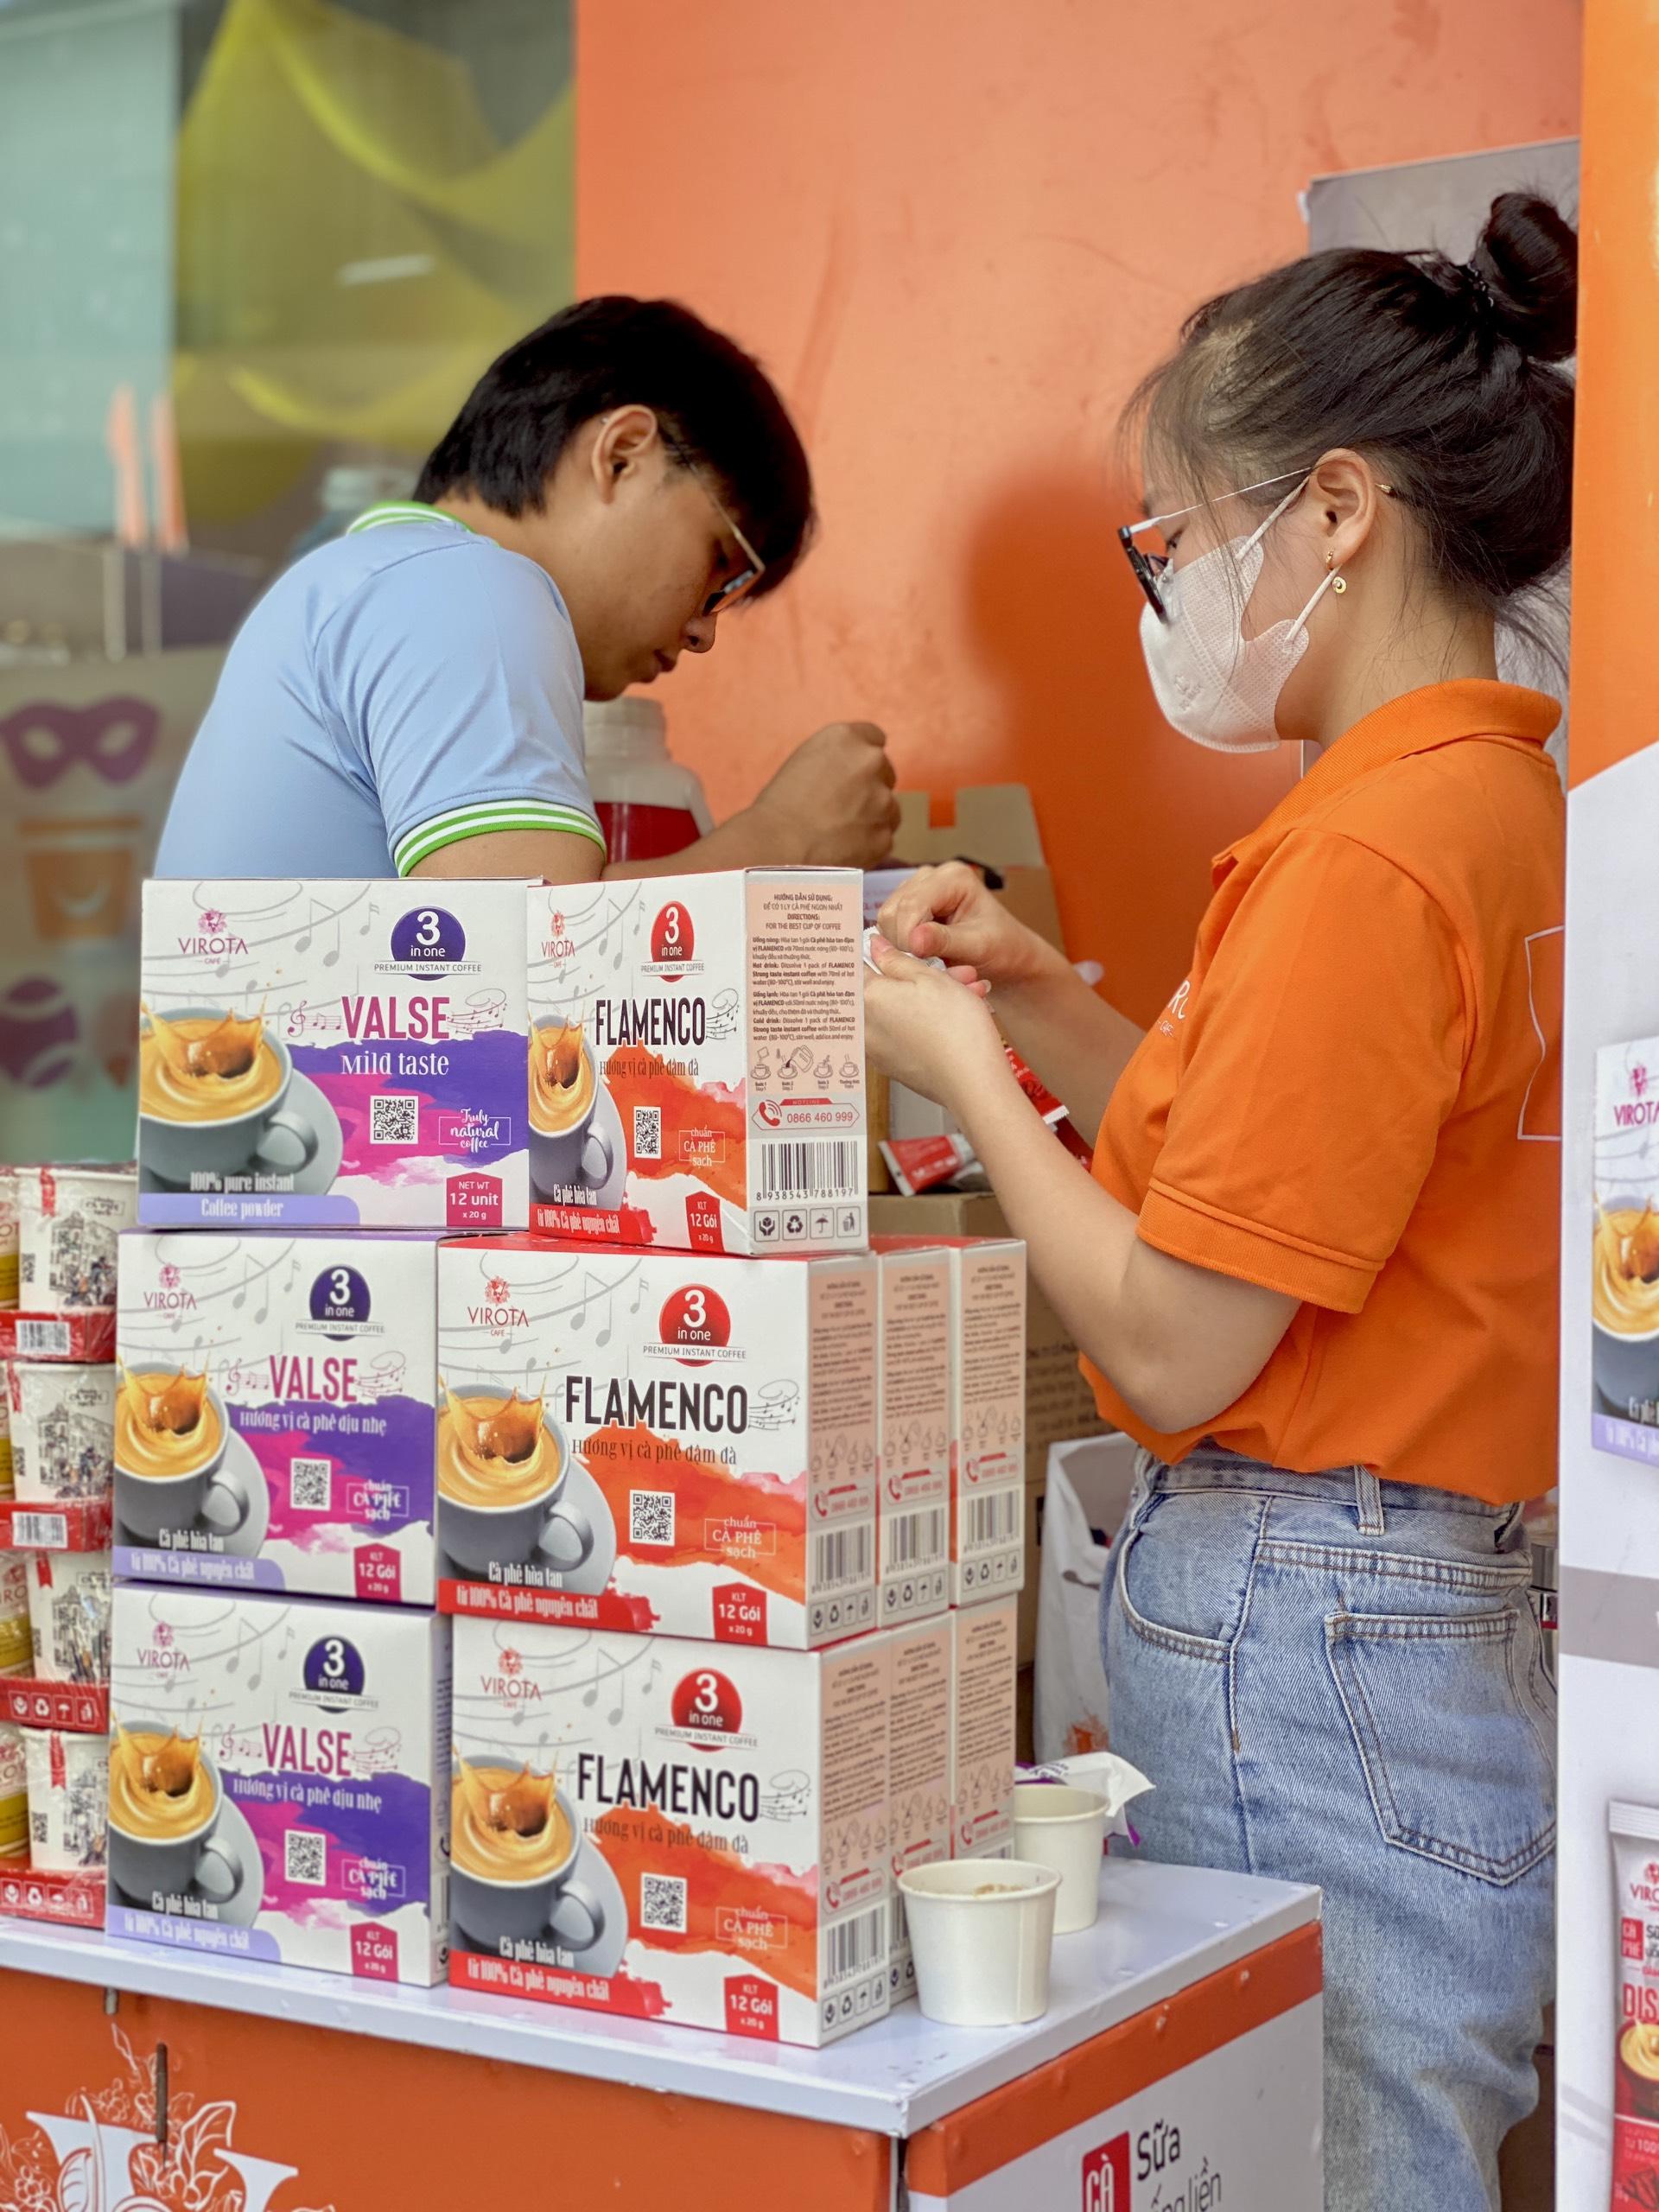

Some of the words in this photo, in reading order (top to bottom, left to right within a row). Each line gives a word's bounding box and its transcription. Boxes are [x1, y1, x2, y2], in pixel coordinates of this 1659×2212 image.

[416, 911, 441, 945] 3
[664, 906, 679, 944] 3
[178, 938, 249, 955] VIROTA
[410, 944, 421, 957] in
[423, 948, 446, 957] one
[541, 940, 576, 957] VIROTA
[661, 944, 668, 957] in
[669, 945, 683, 957] one
[416, 963, 449, 972] INSTANT
[640, 964, 663, 974] PREMIUM
[664, 963, 685, 972] INSTANT
[686, 963, 705, 972] COFFEE
[341, 995, 450, 1039] VALSE
[595, 996, 706, 1046] FLAMENCO
[340, 1050, 392, 1075] Mild
[397, 1052, 449, 1076] taste
[461, 1108, 490, 1127] Truly
[787, 1113, 811, 1123] 0866
[815, 1112, 832, 1122] 460
[836, 1111, 853, 1122] 999
[450, 1121, 499, 1141] natural
[460, 1137, 489, 1154] coffee
[224, 1175, 252, 1194] pure
[254, 1171, 295, 1192] instant
[458, 1181, 474, 1190] NET
[476, 1181, 490, 1190] WT
[449, 1192, 467, 1205] 12
[471, 1192, 499, 1206] unit
[200, 1198, 238, 1217] Coffee
[240, 1198, 283, 1220] powder
[690, 1213, 702, 1227] 12
[329, 1268, 350, 1306] 3
[143, 1291, 197, 1310] VIROTA
[683, 1289, 707, 1328] 3
[325, 1304, 334, 1316] in
[335, 1306, 355, 1318] one
[467, 1306, 529, 1327] VIROTA
[677, 1327, 687, 1340] in
[690, 1331, 711, 1341] one
[643, 1345, 680, 1356] PREMIUM
[682, 1347, 715, 1357] INSTANT
[717, 1349, 747, 1359] COFFEE
[270, 1355, 358, 1402] VALSE
[565, 1375, 748, 1434] FLAMENCO
[359, 1563, 374, 1578] 12
[731, 1592, 747, 1603] KLT
[719, 1603, 736, 1619] 12
[739, 1605, 762, 1622] Gói
[323, 1638, 345, 1677] 3
[318, 1674, 328, 1688] in
[329, 1678, 349, 1691] one
[480, 1675, 543, 1701] VIROTA
[694, 1673, 718, 1713] 3
[689, 1710, 699, 1724] in
[701, 1713, 724, 1727] one
[263, 1722, 352, 1777] VALSE
[578, 1752, 760, 1823] FLAMENCO
[355, 1941, 372, 1956] 12
[729, 1994, 747, 2012] 12
[1137, 2119, 1180, 2182] Sữa
